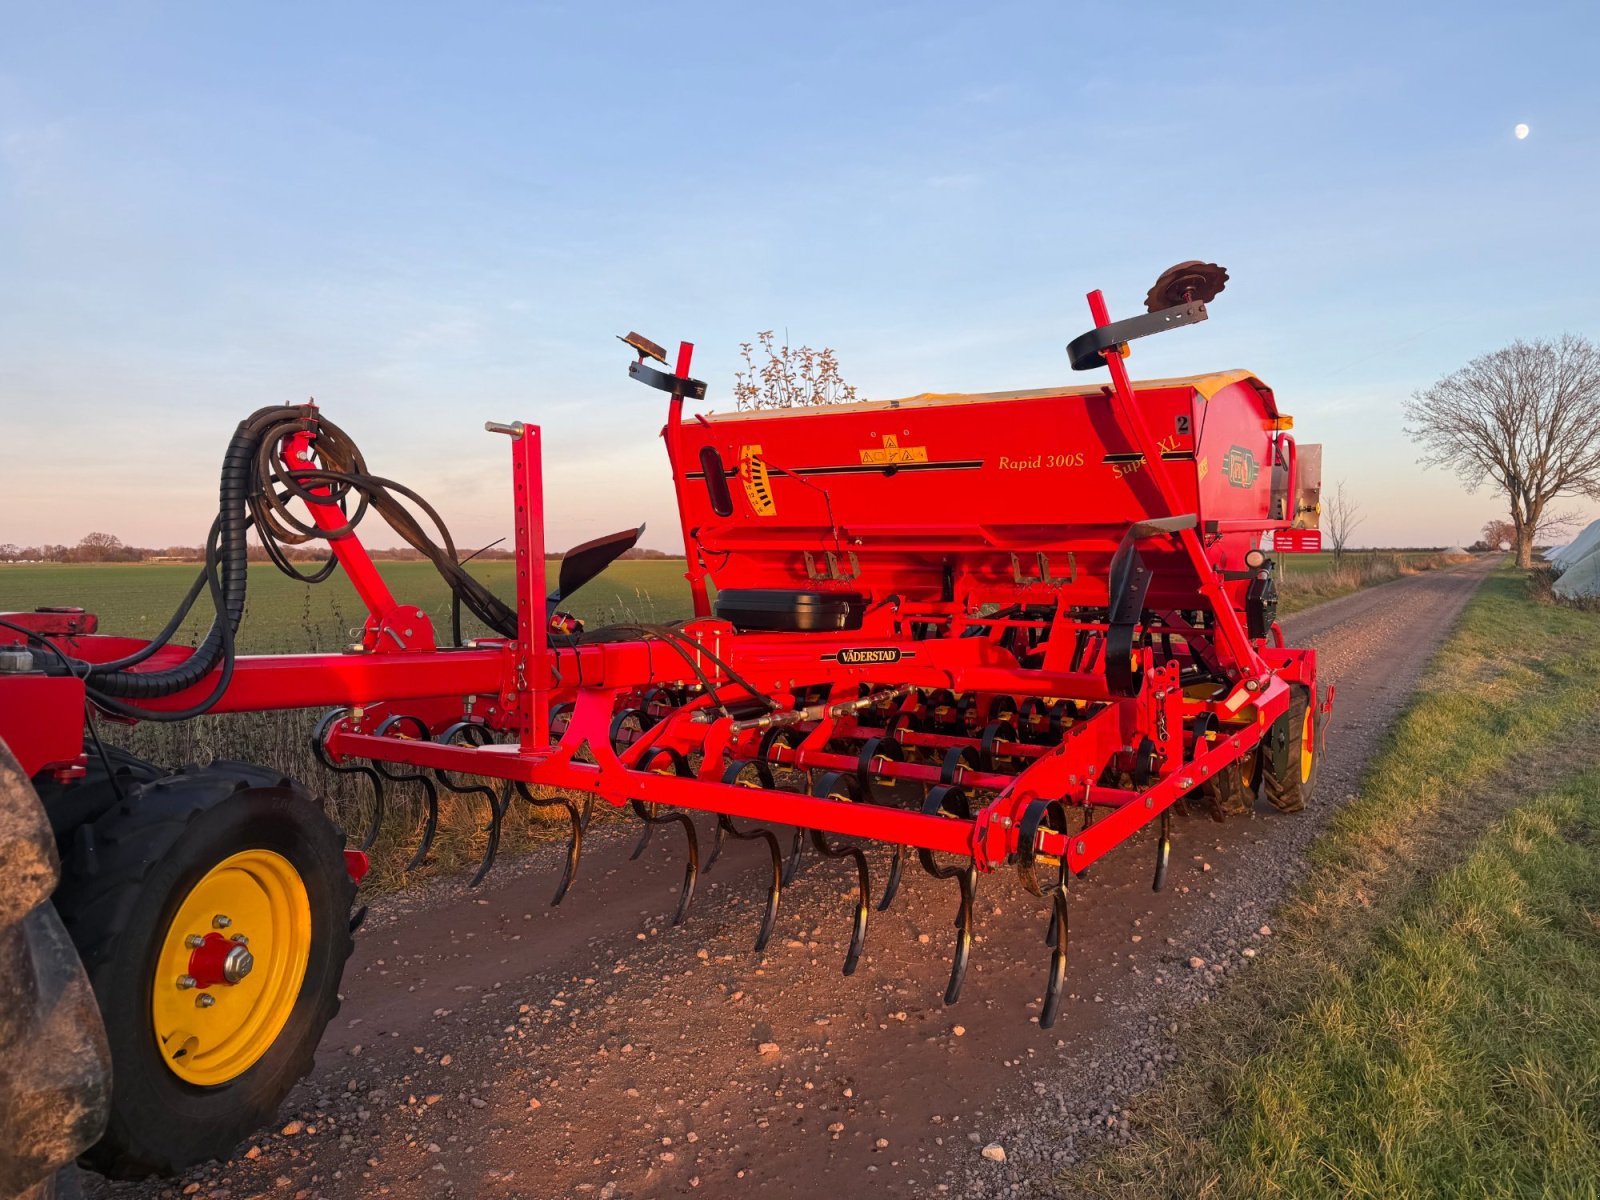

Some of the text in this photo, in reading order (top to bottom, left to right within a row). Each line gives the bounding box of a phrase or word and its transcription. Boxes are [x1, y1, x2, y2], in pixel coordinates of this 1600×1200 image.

[1177, 416, 1189, 432] 2
[999, 452, 1084, 472] Rapid 300S
[1112, 434, 1181, 480] Supe XL
[842, 649, 896, 662] VÄDERSTAD
